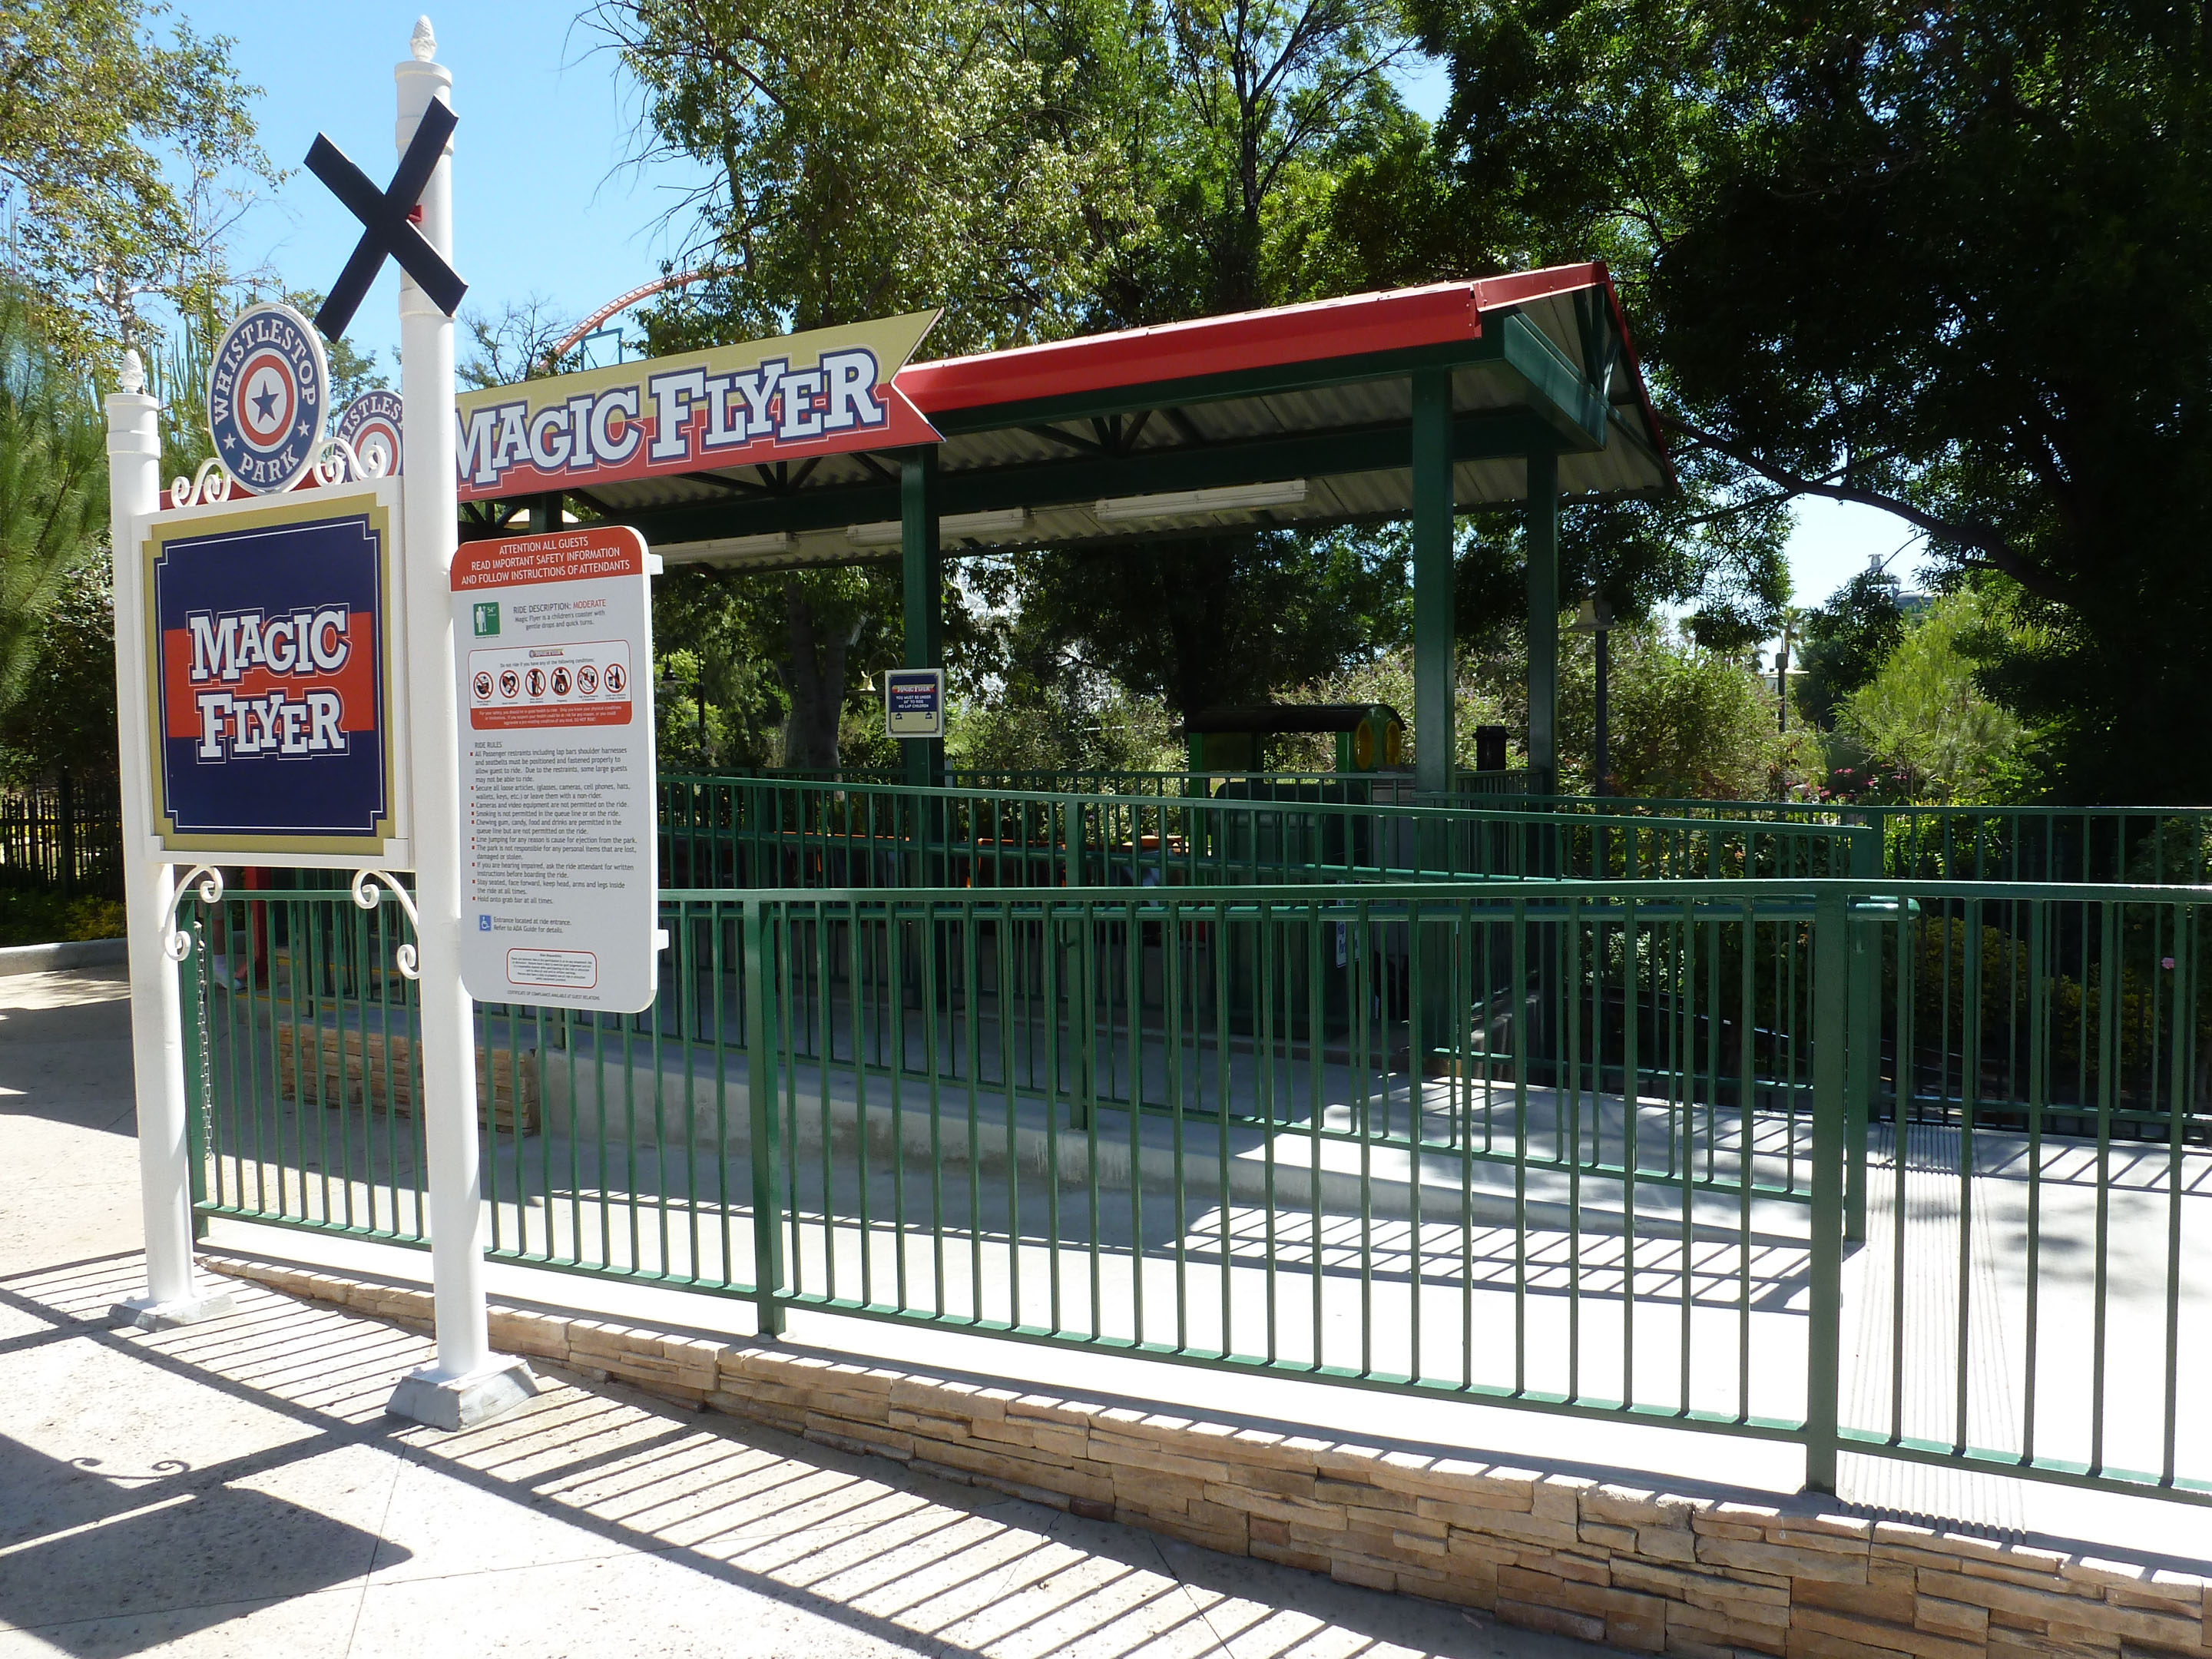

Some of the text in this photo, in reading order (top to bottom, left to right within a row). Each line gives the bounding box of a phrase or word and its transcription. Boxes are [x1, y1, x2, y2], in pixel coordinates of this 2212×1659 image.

[214, 319, 316, 425] WHISTLESTOP
[456, 351, 884, 485] MAGIC FLYER
[238, 444, 299, 483] PARK
[472, 547, 620, 571] READ IMPORTANT SAFETY INFORMATION
[499, 536, 589, 555] ATTENTION ALL GUESTS
[462, 560, 630, 585] AND FOLLOW INSTRUCTIONS OF ATTENDANTS
[529, 603, 571, 613] DESCRIPTION:
[573, 599, 606, 608] MODERATE
[190, 610, 348, 680] MAGIC
[198, 693, 346, 757] FLYER
